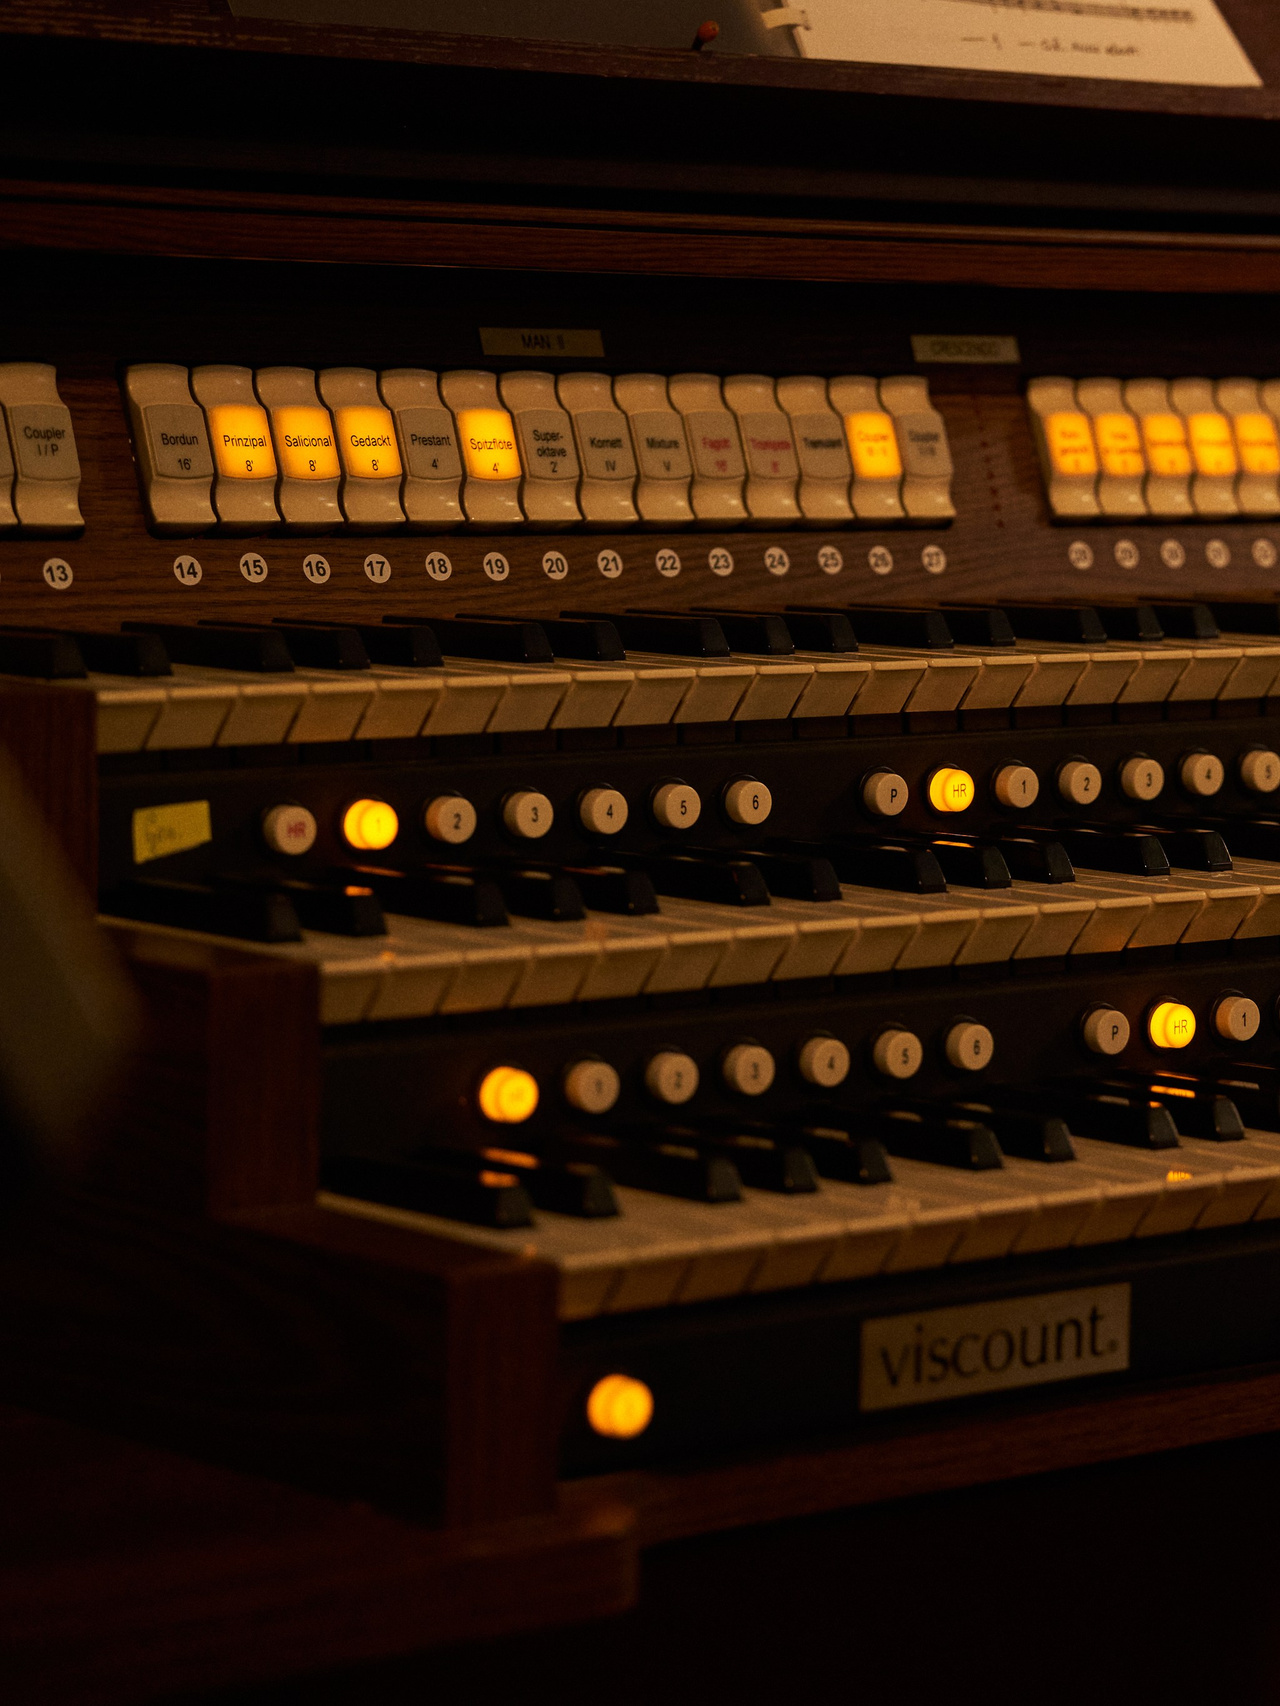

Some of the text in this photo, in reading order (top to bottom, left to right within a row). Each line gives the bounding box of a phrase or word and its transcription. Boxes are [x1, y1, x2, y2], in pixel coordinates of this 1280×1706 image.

[520, 333, 552, 350] MAN
[23, 425, 66, 442] Coupler
[160, 432, 199, 446] Bordun
[222, 433, 268, 450] Prinzipal
[284, 433, 333, 448] Salicional
[350, 434, 392, 448] Gedackt
[410, 433, 452, 447] Prestant
[532, 429, 564, 444] Super-
[242, 559, 264, 577] 15
[305, 560, 327, 577] 16
[366, 560, 386, 577] 17
[427, 558, 448, 575] 18
[485, 558, 505, 575] 19
[545, 557, 565, 574] 20
[600, 556, 619, 572] 21
[658, 555, 678, 571] 22
[711, 554, 730, 570] 23
[768, 554, 786, 569] 24
[45, 564, 69, 583] 13
[175, 561, 198, 579] 14
[1021, 779, 1027, 794] 1
[1083, 776, 1090, 792] 2
[1146, 772, 1153, 788] 3
[890, 788, 898, 804] P
[951, 783, 969, 799] HR
[680, 799, 688, 816] 5
[752, 794, 760, 811] 6
[531, 806, 539, 823] 3
[606, 804, 614, 819] 4
[453, 812, 462, 831] 2
[1173, 1019, 1188, 1034] HR
[1241, 1012, 1247, 1027] 1
[1111, 1024, 1119, 1040] P
[973, 1039, 981, 1056] 6
[827, 1056, 835, 1070] 4
[901, 1047, 910, 1065] 5
